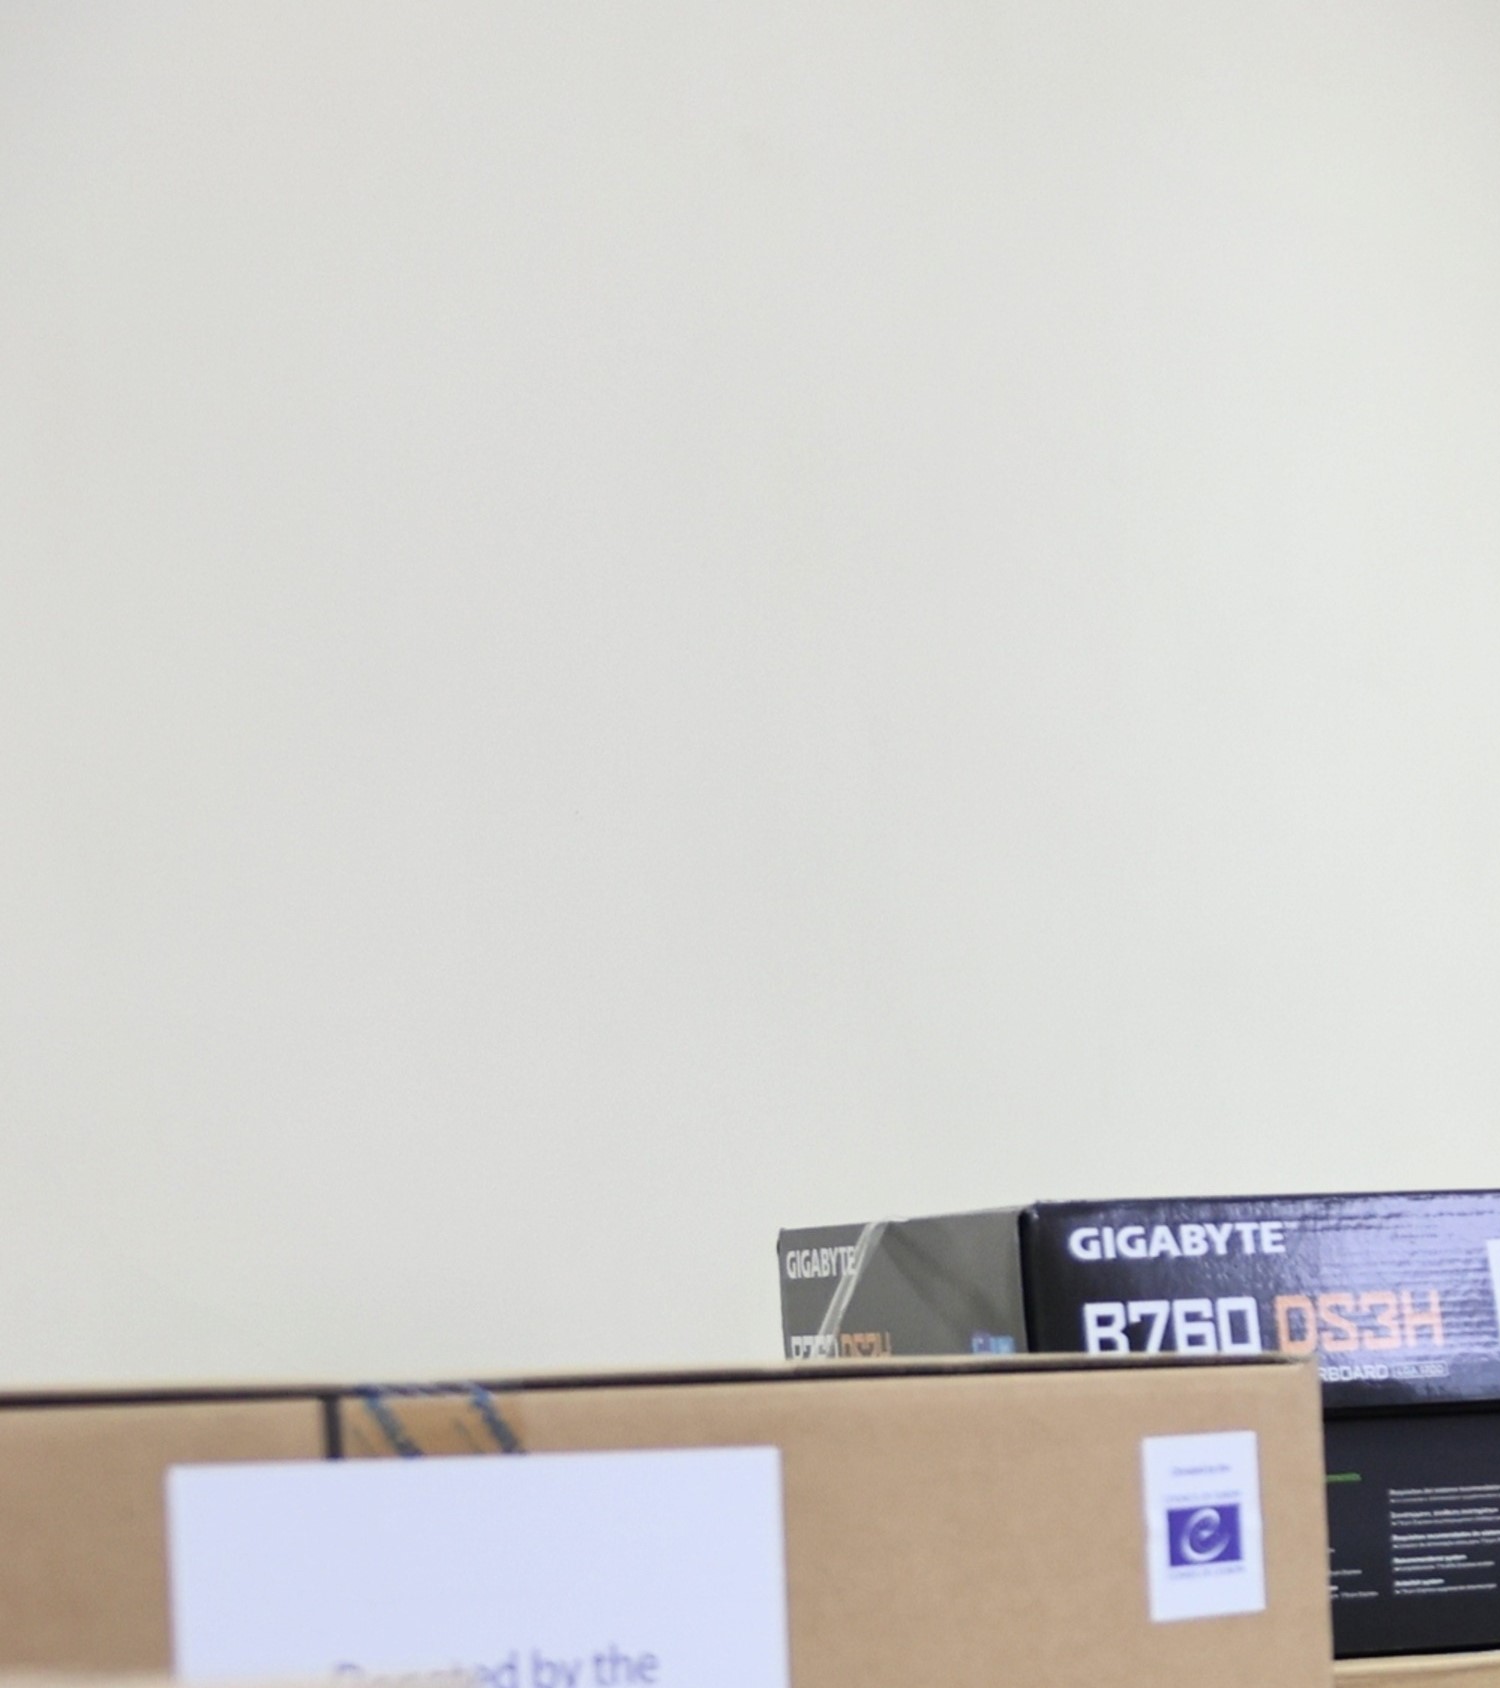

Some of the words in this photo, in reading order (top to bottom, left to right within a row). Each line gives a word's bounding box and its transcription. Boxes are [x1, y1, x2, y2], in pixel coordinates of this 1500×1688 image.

[786, 1245, 858, 1279] GIGABYTE
[1069, 1221, 1286, 1261] GIGABYTE
[1084, 1296, 1263, 1354] B760
[1275, 1289, 1445, 1354] DS3H
[593, 1643, 660, 1688] the
